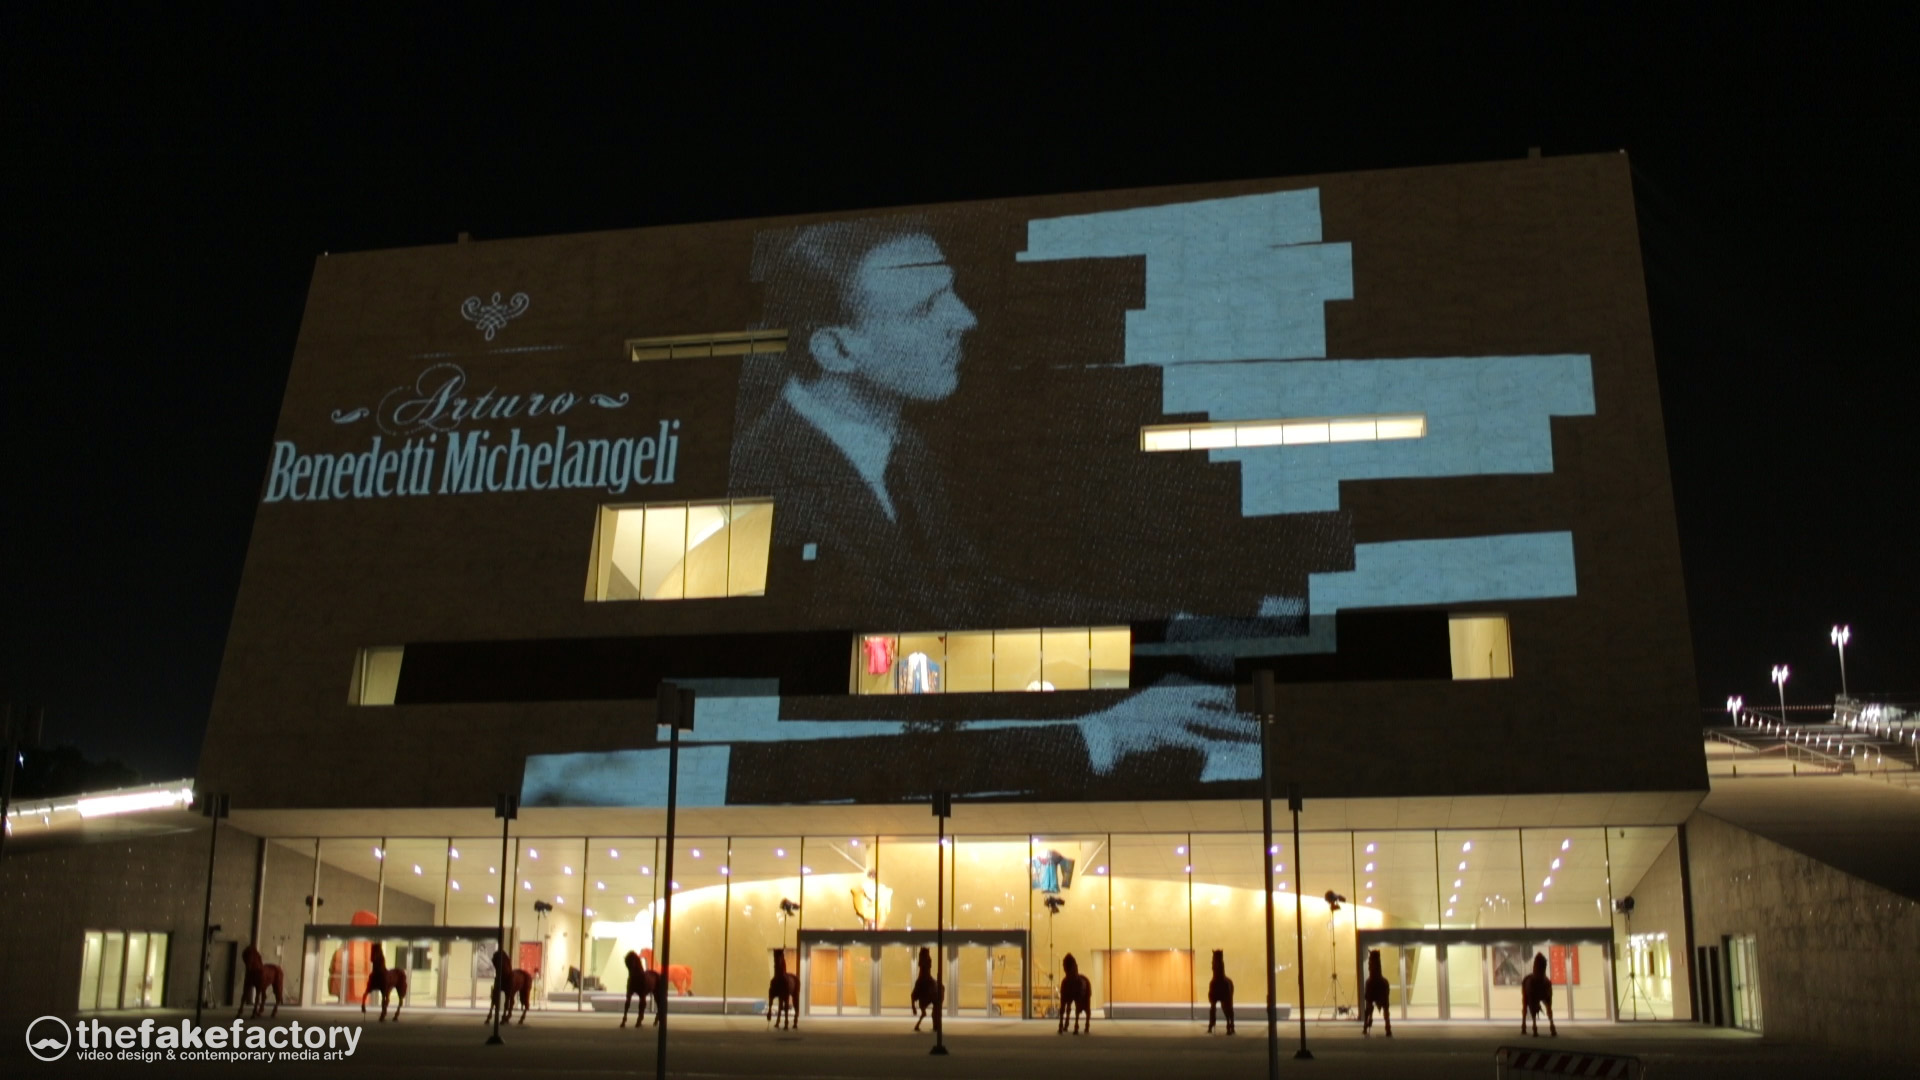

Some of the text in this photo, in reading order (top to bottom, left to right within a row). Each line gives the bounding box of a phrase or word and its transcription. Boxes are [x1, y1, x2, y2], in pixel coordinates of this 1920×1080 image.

[377, 363, 582, 435] Arturo
[263, 419, 681, 503] Benedetti Michelangeli
